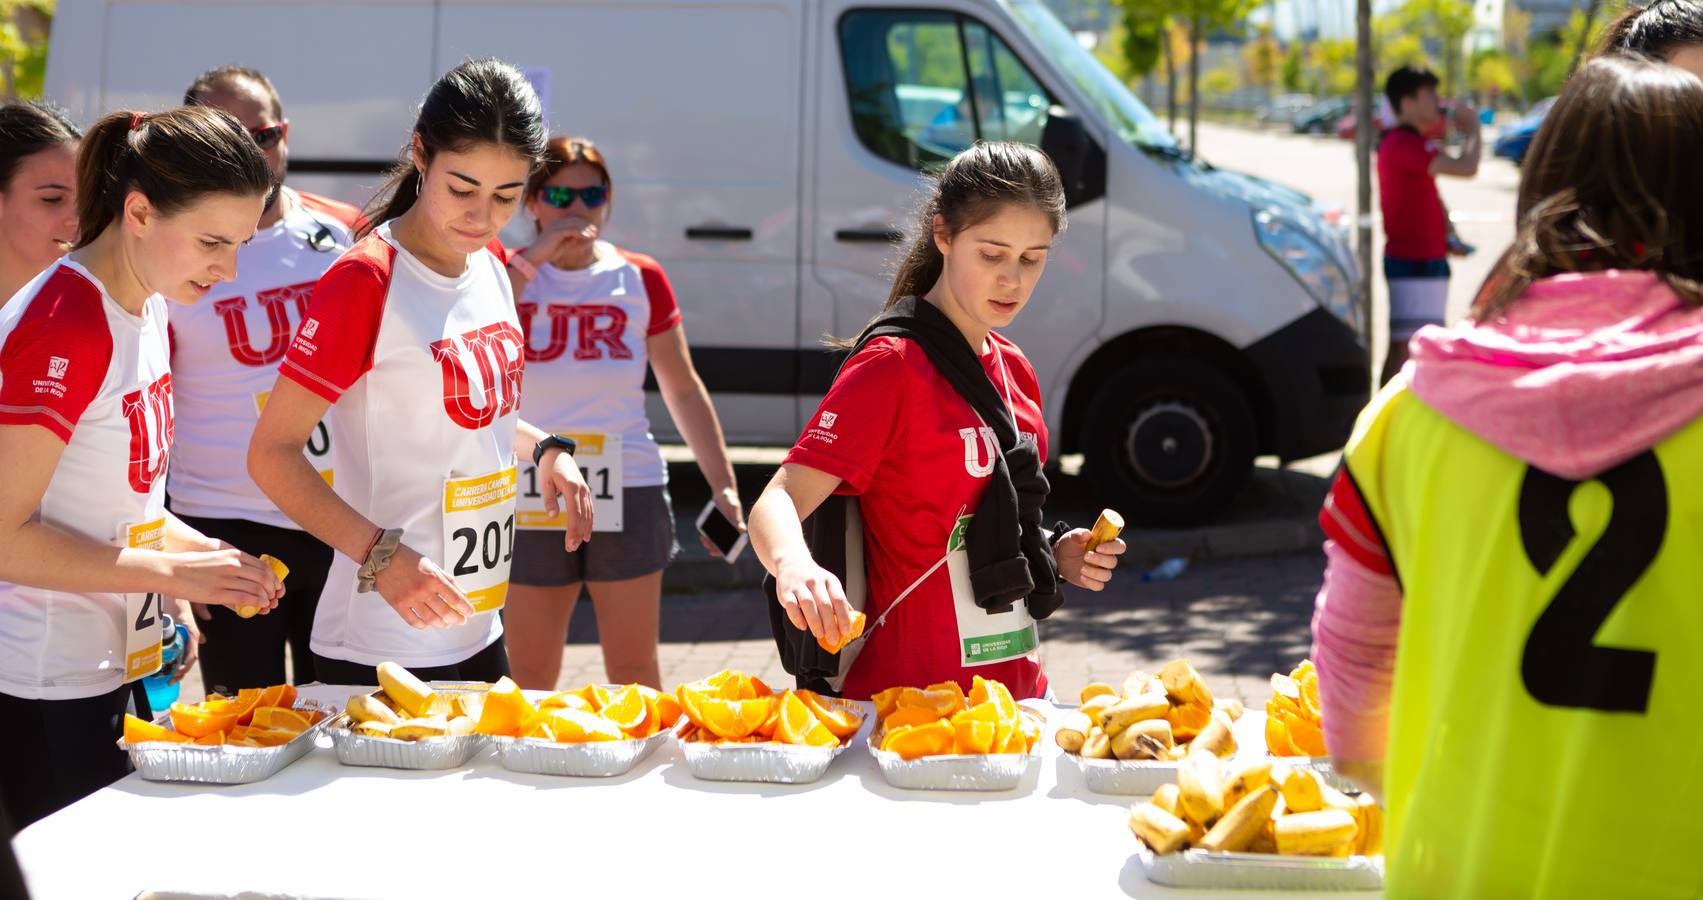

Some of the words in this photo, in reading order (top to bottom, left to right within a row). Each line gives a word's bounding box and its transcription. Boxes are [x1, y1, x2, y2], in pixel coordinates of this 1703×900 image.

[517, 303, 633, 362] UR
[430, 321, 525, 430] UR
[452, 490, 496, 508] UNIVERSIDAD
[454, 483, 487, 497] CARRERA
[452, 514, 514, 577] 201
[1518, 448, 1670, 716] 2
